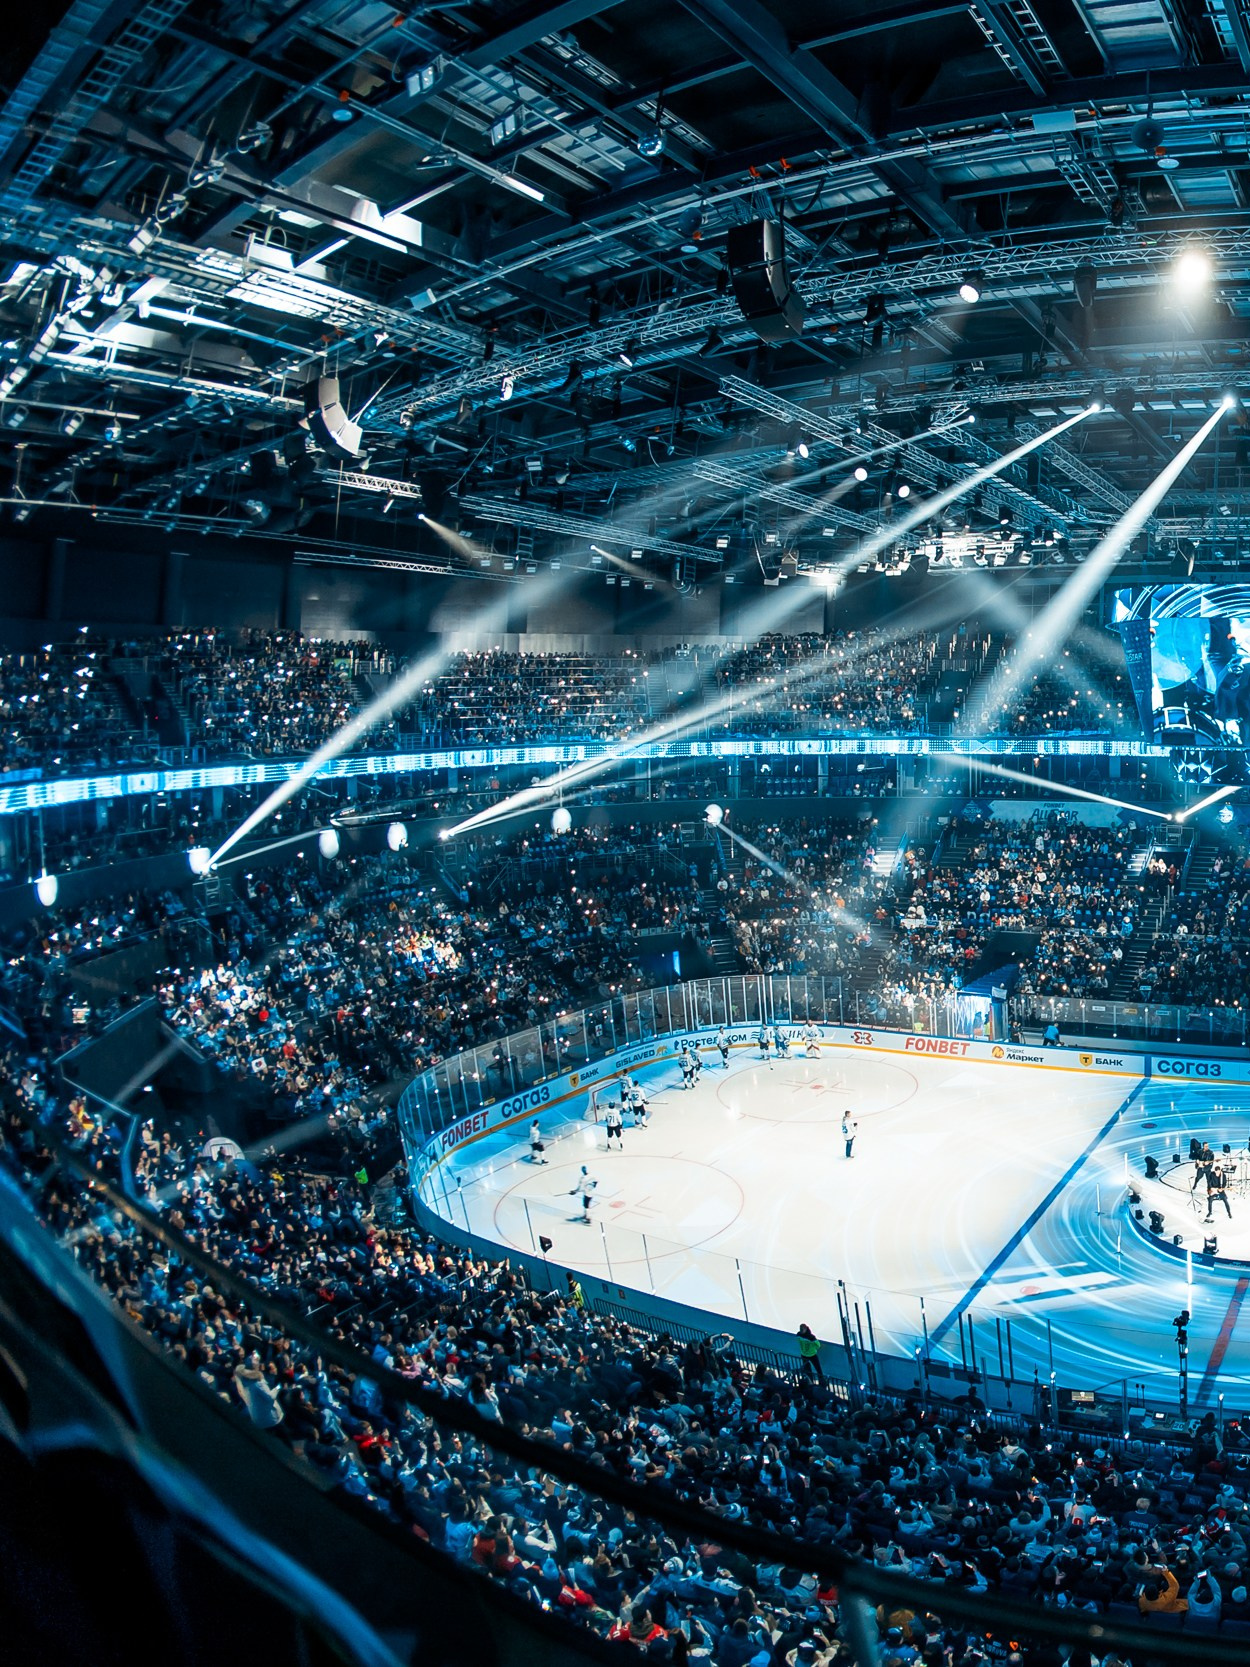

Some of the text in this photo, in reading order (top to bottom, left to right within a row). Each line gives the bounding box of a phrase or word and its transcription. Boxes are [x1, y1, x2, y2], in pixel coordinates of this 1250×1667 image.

[681, 1033, 747, 1049] Ростелком
[905, 1037, 970, 1055] FONBET
[616, 1049, 655, 1068] GISLAVED
[1006, 1053, 1044, 1062] Маркет
[1095, 1058, 1123, 1066] БАНК
[580, 1068, 599, 1081] БАНК
[442, 1111, 489, 1152] FONBET
